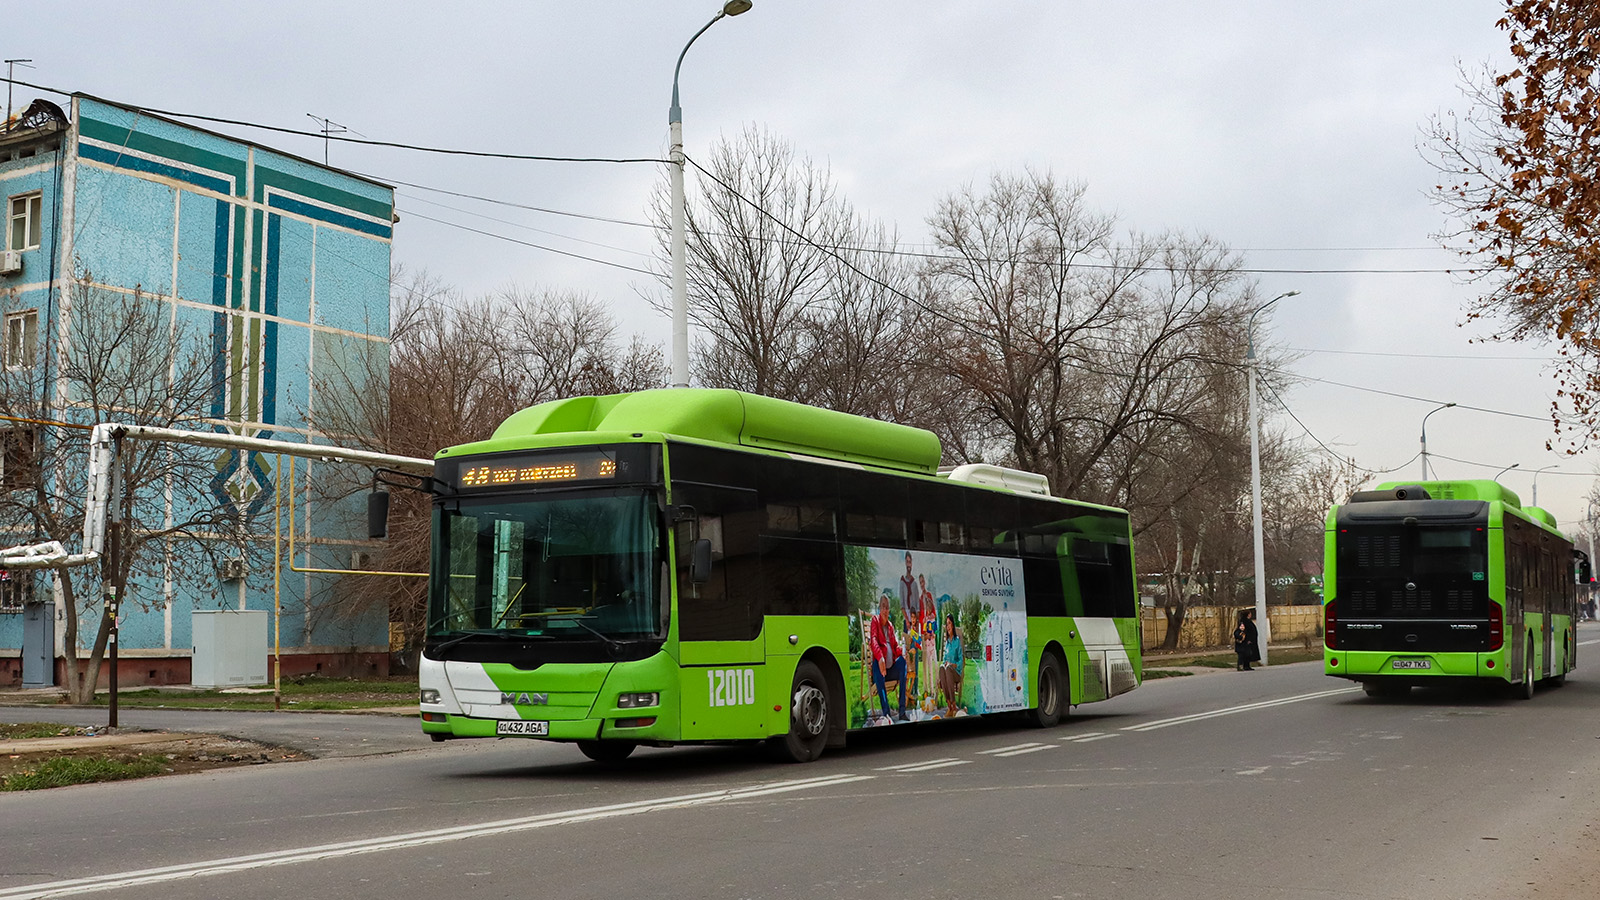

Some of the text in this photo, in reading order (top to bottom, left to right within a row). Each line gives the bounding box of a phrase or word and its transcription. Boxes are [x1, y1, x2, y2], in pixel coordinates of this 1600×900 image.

[707, 668, 755, 707] 12010
[500, 692, 548, 705] MAN
[507, 722, 524, 733] 432
[525, 722, 543, 733] AGA
